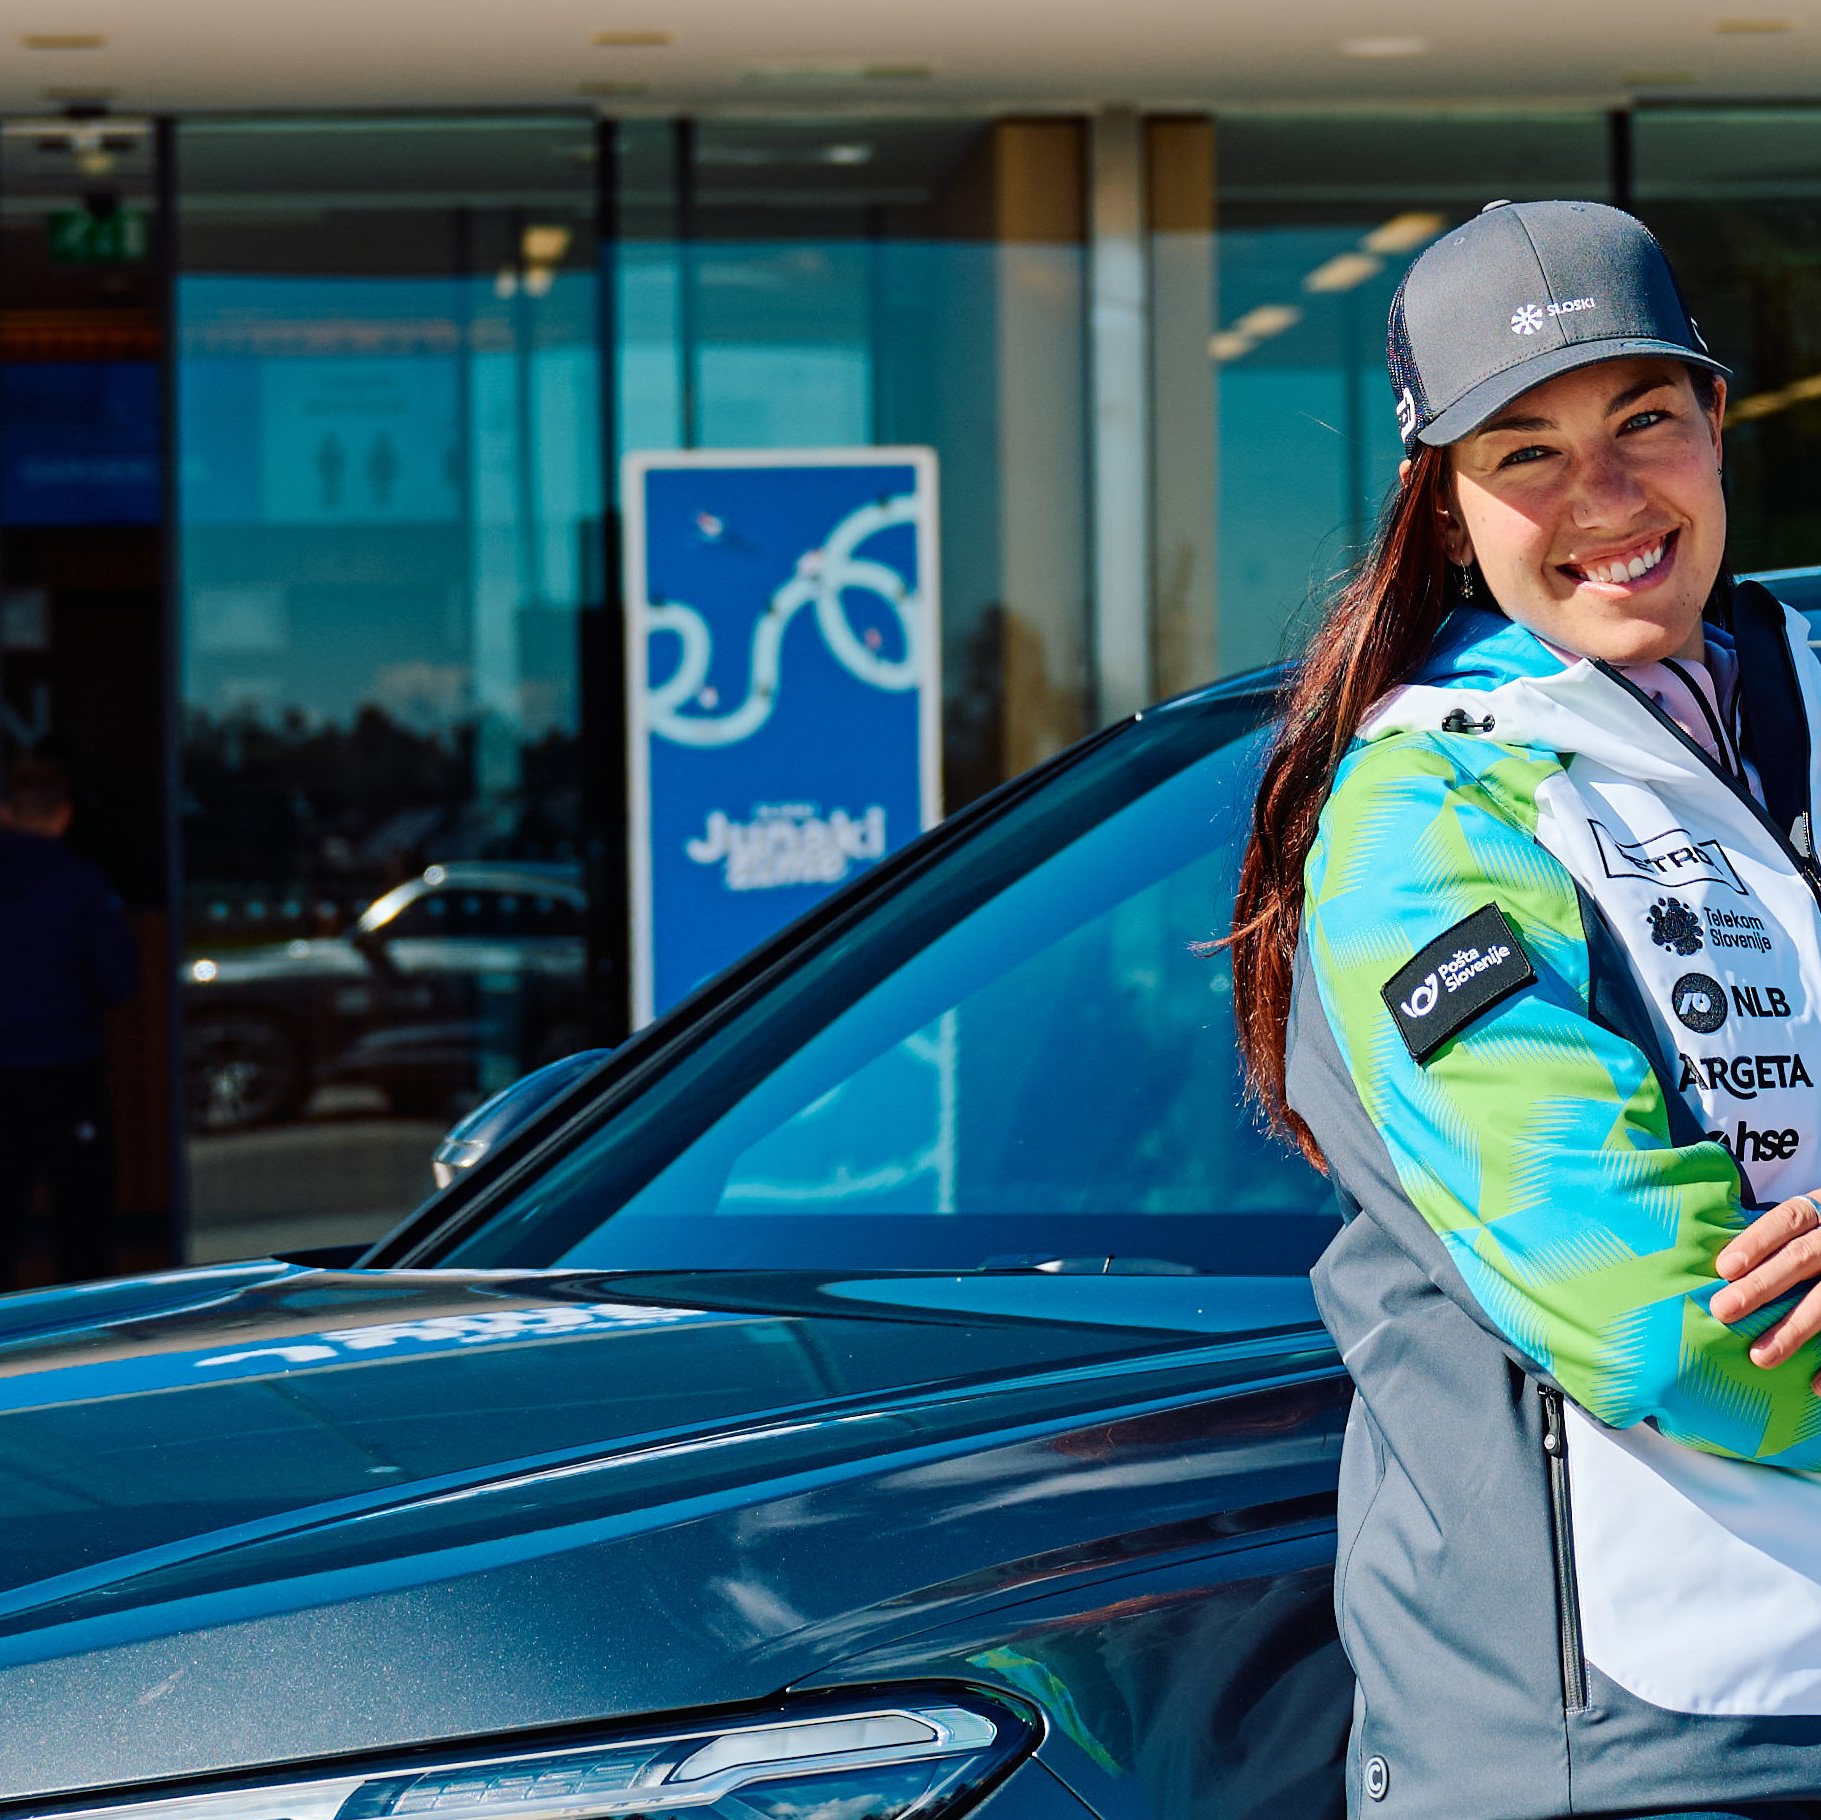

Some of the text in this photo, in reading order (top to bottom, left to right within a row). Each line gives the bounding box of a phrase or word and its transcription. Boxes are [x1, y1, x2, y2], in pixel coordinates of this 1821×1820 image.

[1703, 906, 1765, 931] Telekom
[1709, 928, 1772, 953] Slovenije
[1445, 945, 1511, 992] Slovenije
[1731, 985, 1792, 1018] NLB
[1679, 1052, 1814, 1100] ARGETA
[1736, 1120, 1800, 1161] hse
